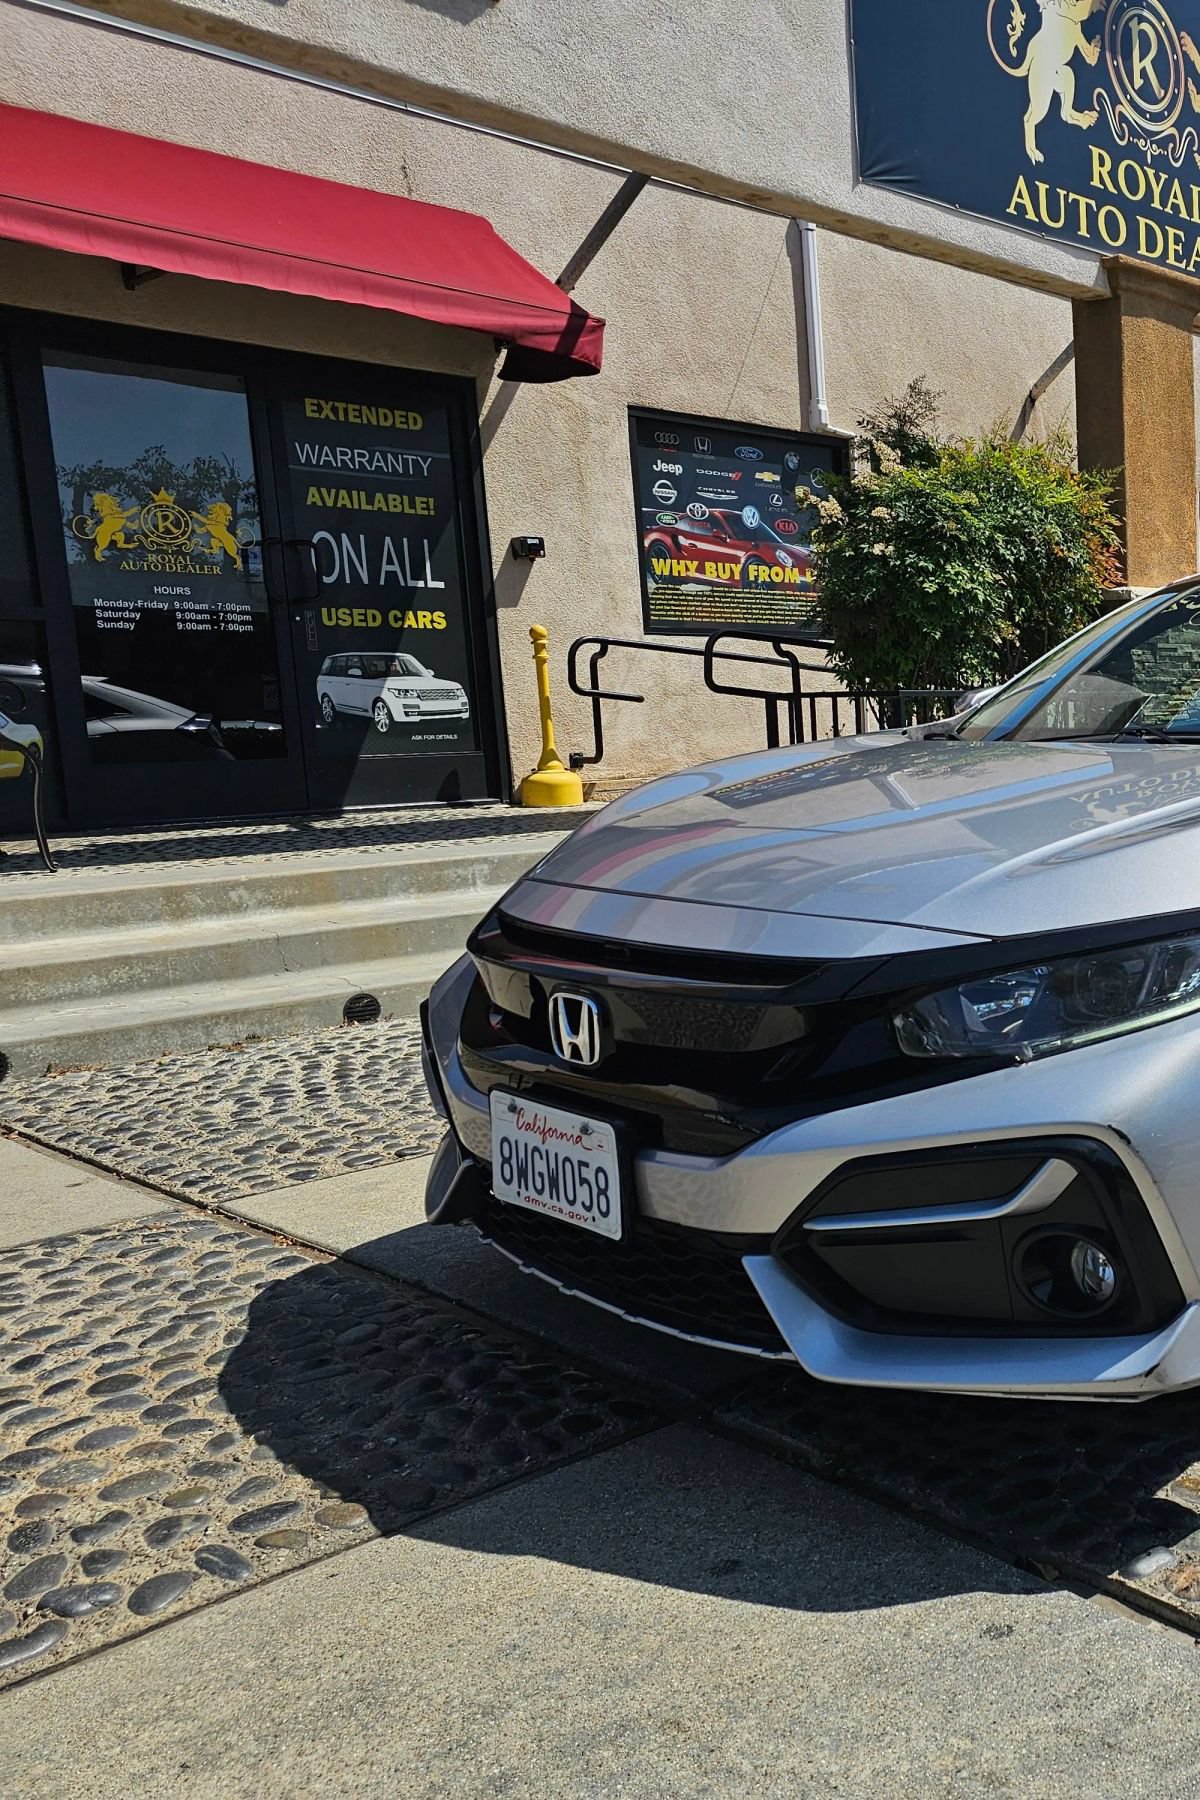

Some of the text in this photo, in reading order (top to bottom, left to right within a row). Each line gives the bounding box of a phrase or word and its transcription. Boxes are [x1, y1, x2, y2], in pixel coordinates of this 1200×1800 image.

[1006, 175, 1127, 248] AUTO
[304, 397, 424, 431] EXTENDED
[294, 441, 433, 477] WARRANTY
[652, 459, 683, 476] Jeep
[695, 468, 736, 478] DODGE
[654, 488, 677, 496] NISSAN
[697, 486, 736, 494] CHRYSLER
[306, 486, 436, 516] AVAILABLE!
[779, 521, 795, 531] KIA
[119, 560, 223, 575] AUTO DEALER
[147, 553, 195, 565] ROYAL
[311, 530, 446, 589] ON ALL
[651, 557, 699, 577] WHY
[704, 561, 743, 580] BUY
[748, 564, 802, 584] FROM
[153, 585, 192, 595] HOURS
[93, 598, 169, 610] Monday-Friday
[173, 601, 209, 610] 9:00am
[216, 602, 251, 611] 7:00pm
[95, 609, 141, 619] Saturday
[175, 612, 210, 620] 9:00am
[218, 613, 252, 622] 7:00pm
[321, 607, 448, 630] USED CARS
[96, 620, 135, 630] Sunday
[176, 622, 212, 631] 9:00am
[219, 623, 254, 632] 7:00pm
[516, 1107, 593, 1151] California
[500, 1136, 611, 1218] 8WGW058
[523, 1195, 590, 1222] dmv.ca.gov
